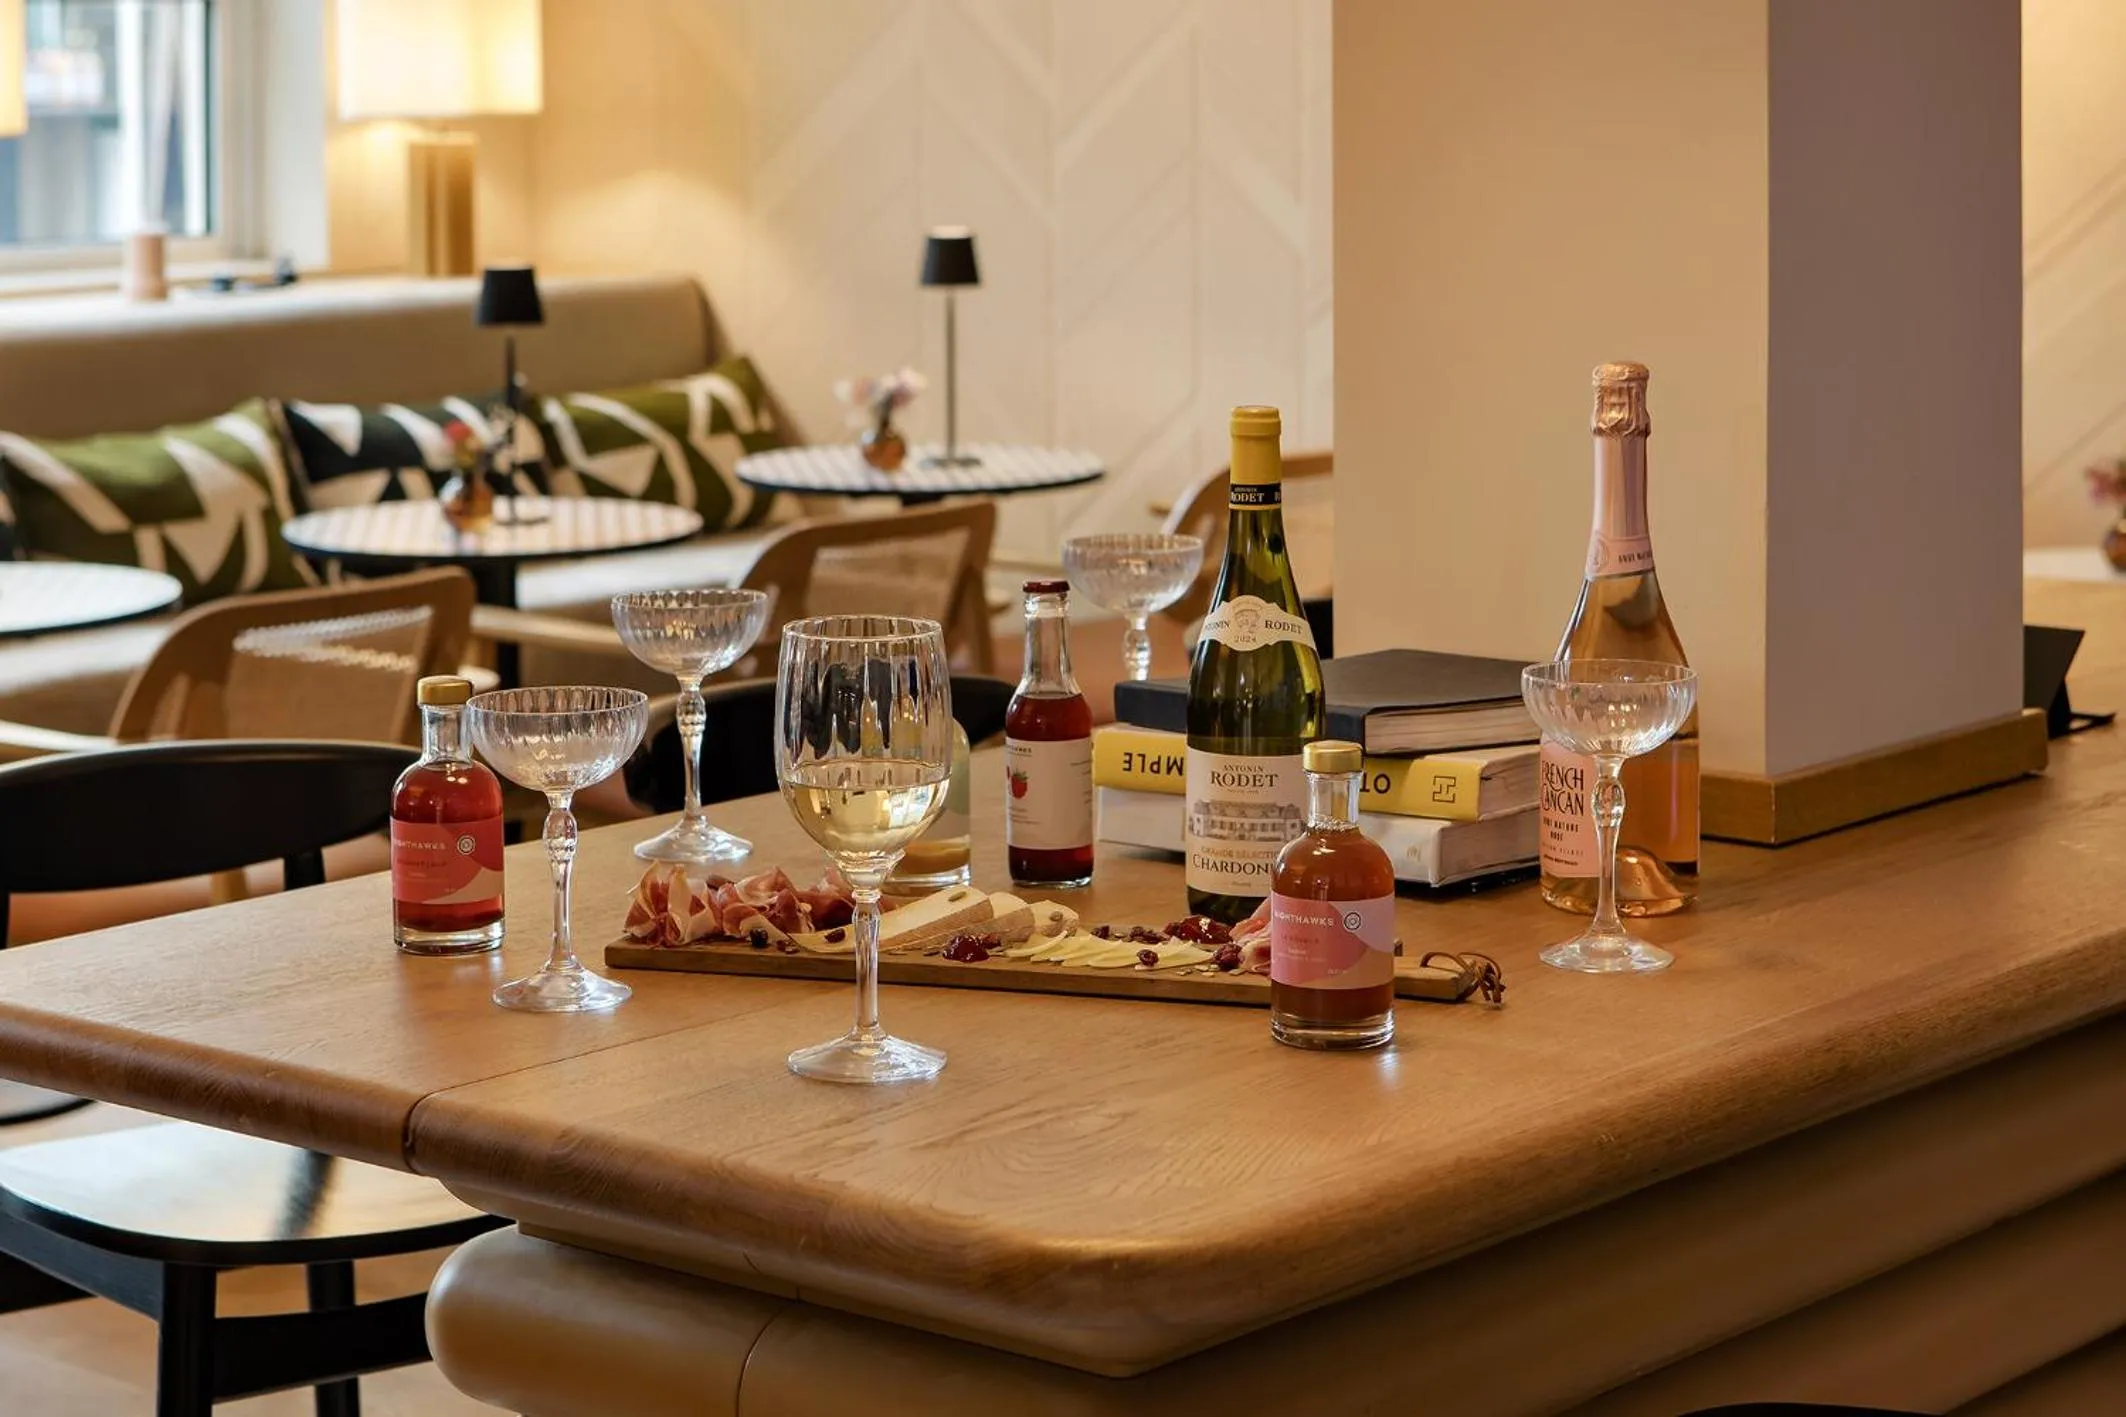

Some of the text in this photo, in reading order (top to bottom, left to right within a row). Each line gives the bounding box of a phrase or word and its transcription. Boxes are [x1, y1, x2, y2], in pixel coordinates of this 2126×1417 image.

[1265, 619, 1303, 634] RODET
[1122, 752, 1185, 777] MPLE
[1223, 764, 1264, 773] ANTONIN
[1210, 770, 1279, 788] RODET
[1541, 760, 1584, 792] FRENCH
